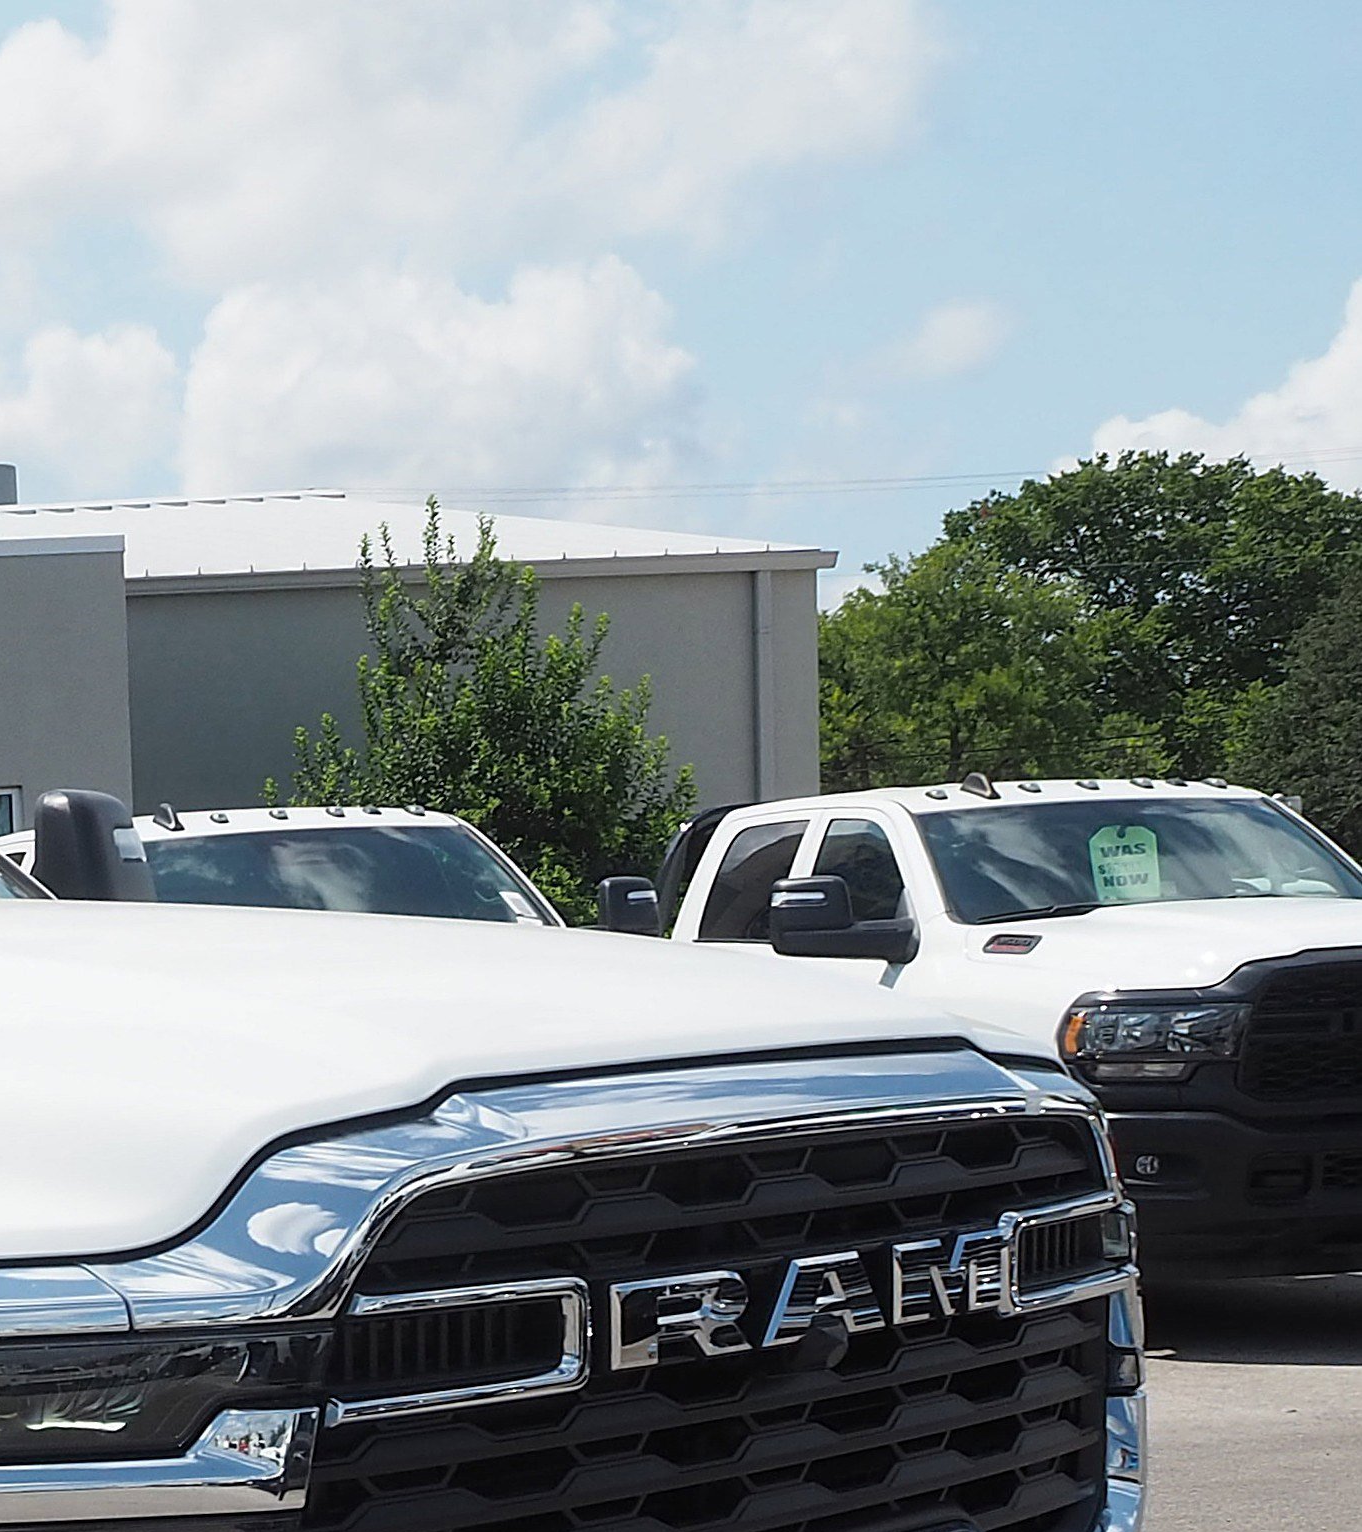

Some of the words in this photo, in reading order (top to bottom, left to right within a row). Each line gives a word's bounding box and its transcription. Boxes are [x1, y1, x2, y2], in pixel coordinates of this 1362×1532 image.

[1100, 843, 1146, 858] WAS
[1103, 873, 1148, 887] NOW
[610, 1227, 1008, 1371] RAM
